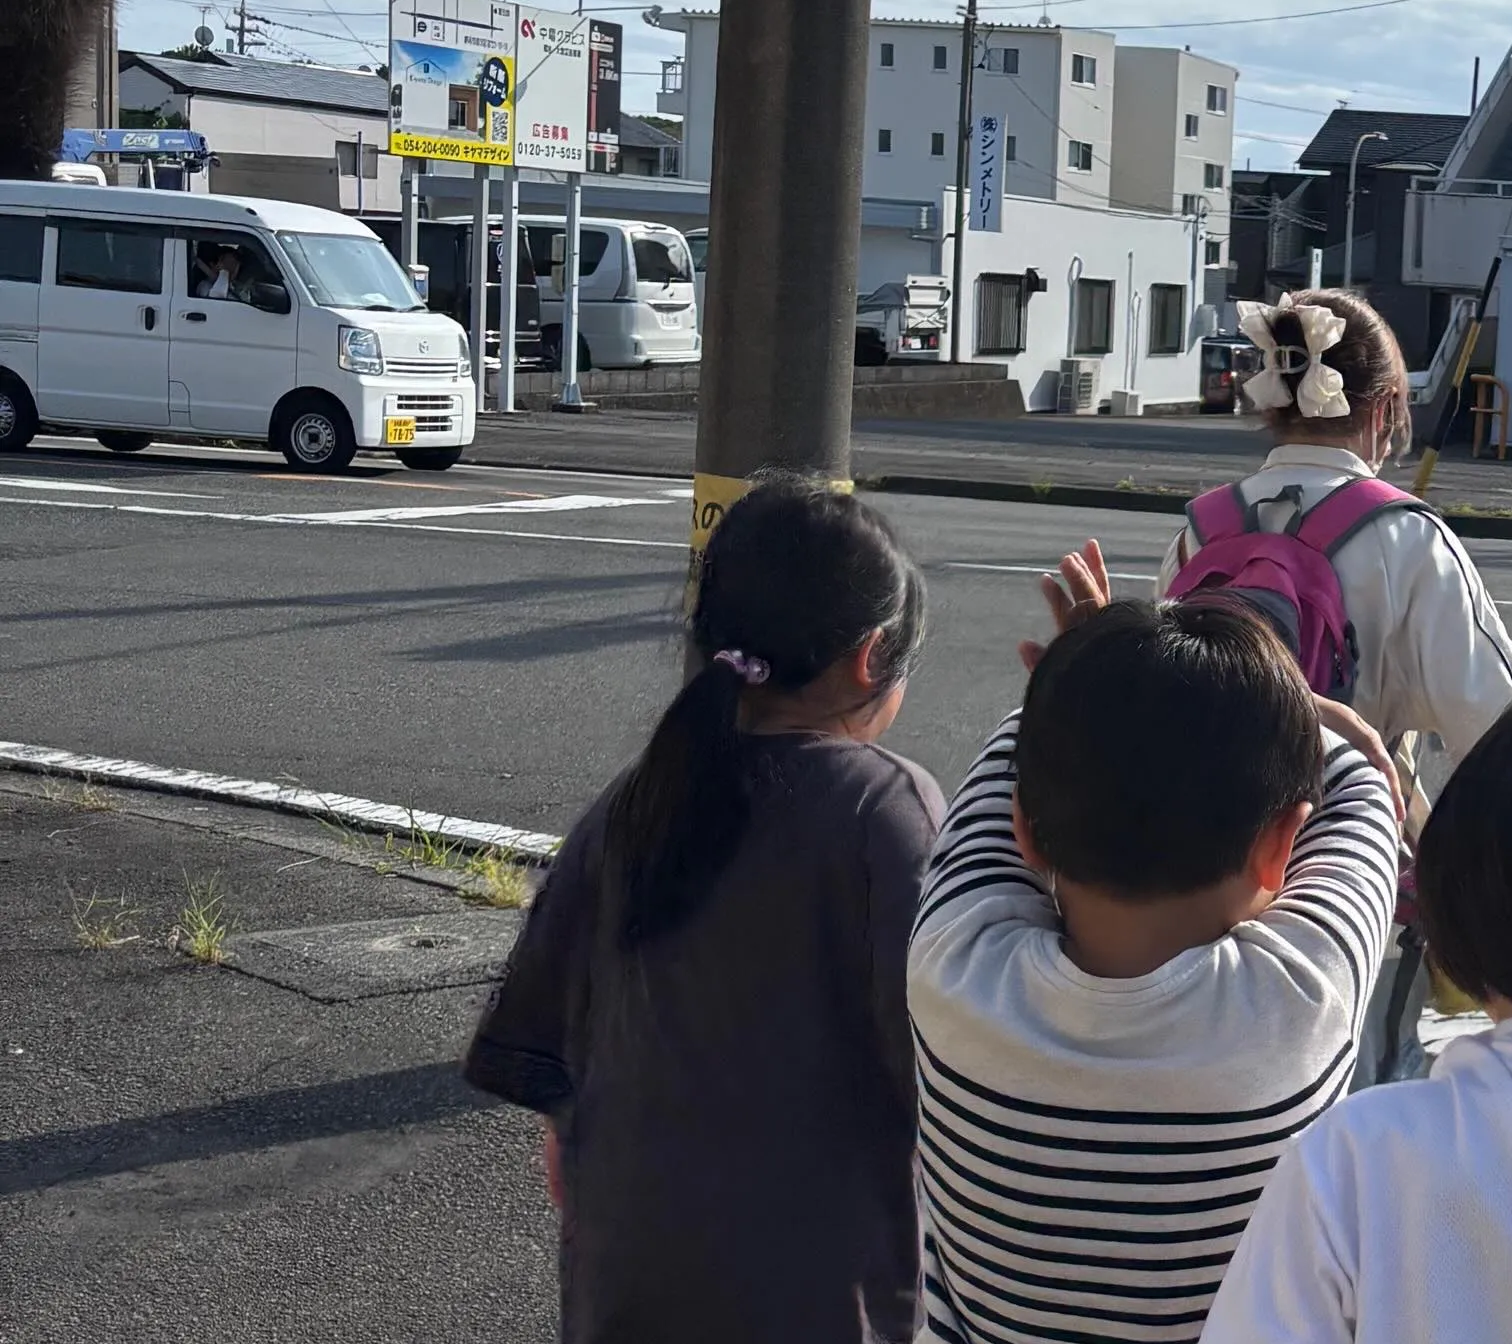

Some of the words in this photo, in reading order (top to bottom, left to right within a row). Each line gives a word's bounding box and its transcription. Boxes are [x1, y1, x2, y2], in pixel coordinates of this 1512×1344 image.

[483, 76, 507, 100] リフォーム
[532, 123, 569, 141] 広告募集
